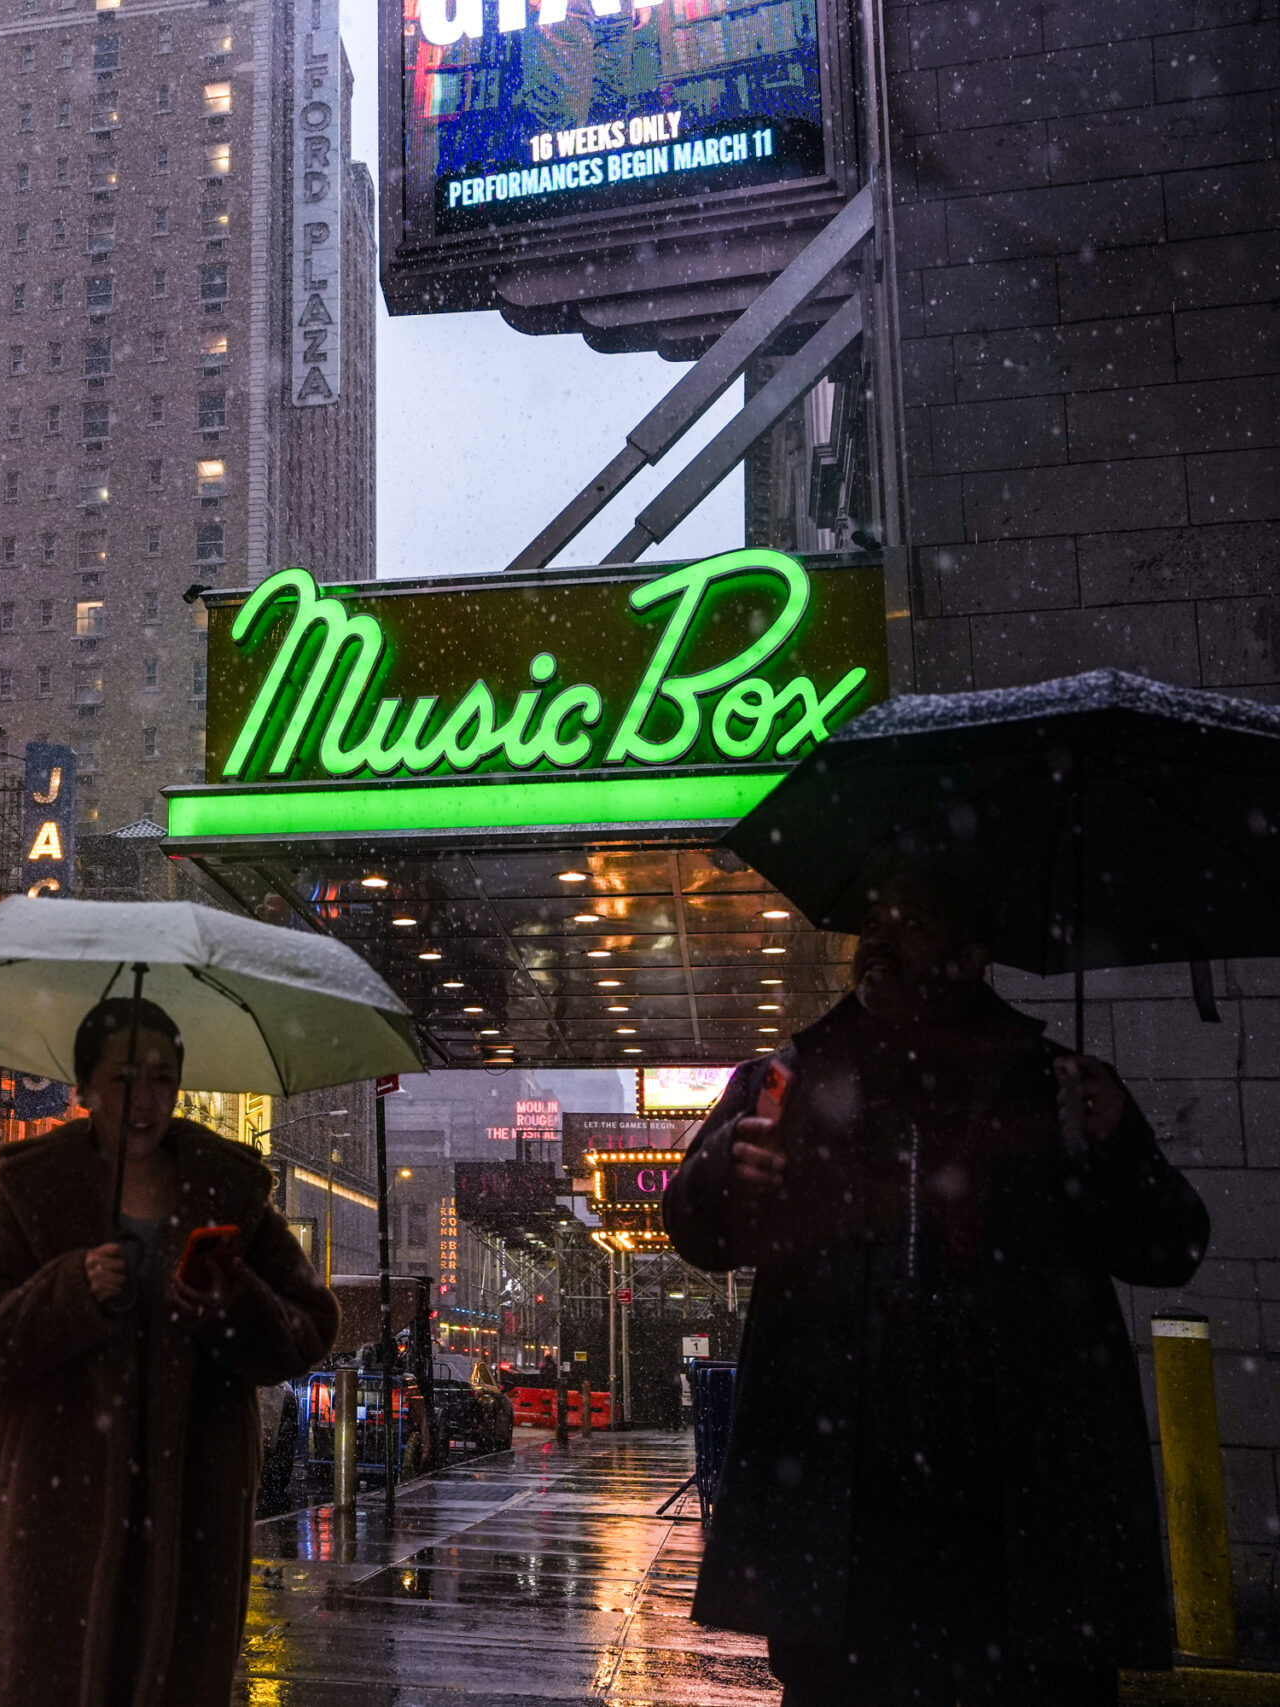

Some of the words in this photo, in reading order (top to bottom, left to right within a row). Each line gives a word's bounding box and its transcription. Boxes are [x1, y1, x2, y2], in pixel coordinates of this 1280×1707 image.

[529, 134, 553, 162] 16
[557, 121, 625, 156] WEEKS
[630, 111, 683, 145] ONLY
[448, 155, 604, 209] PERFORMANCES
[608, 149, 669, 184] BEGIN
[673, 136, 749, 171] MARCH
[753, 128, 773, 158] 11
[298, 221, 334, 400] PLAZA
[222, 568, 603, 779] Music
[605, 548, 867, 766] Box
[516, 1101, 559, 1113] MOULIN
[516, 1114, 559, 1126] ROUGE!
[486, 1127, 509, 1140] THE
[448, 1197, 457, 1237] IRON
[448, 1241, 457, 1269] BAR
